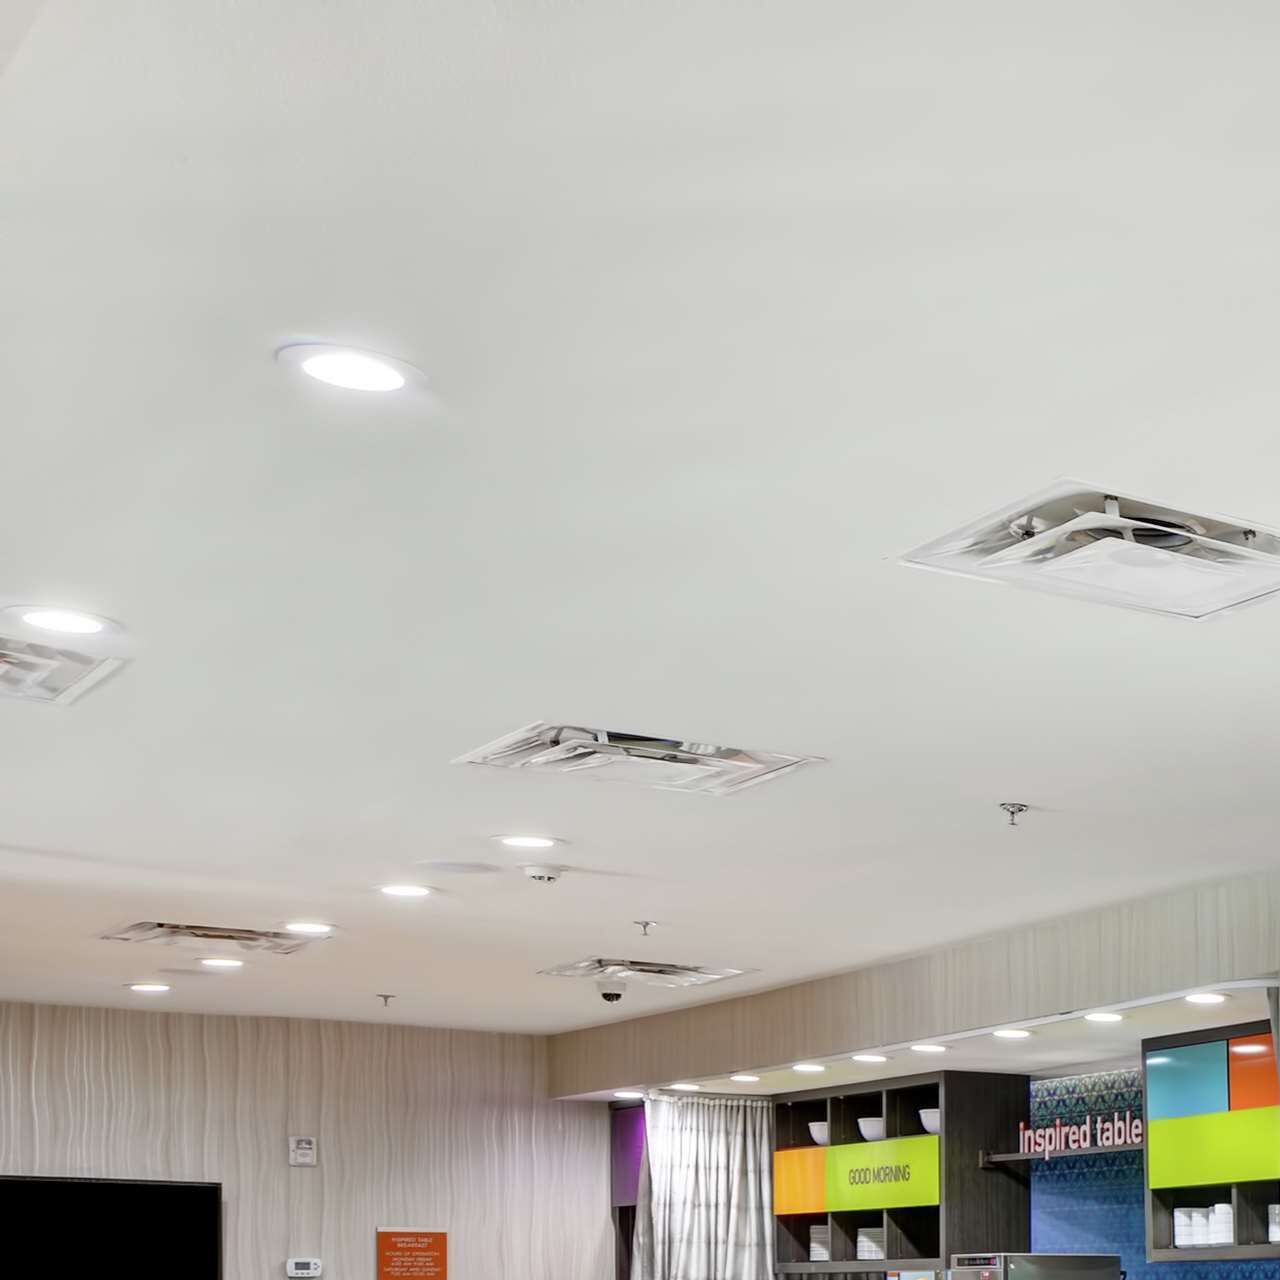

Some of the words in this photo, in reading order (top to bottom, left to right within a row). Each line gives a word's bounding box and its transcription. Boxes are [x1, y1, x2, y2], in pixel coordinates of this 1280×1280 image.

[1020, 1115, 1090, 1160] inspired
[1096, 1111, 1142, 1147] table
[848, 1168, 871, 1185] GOOD
[872, 1164, 911, 1183] MORNING
